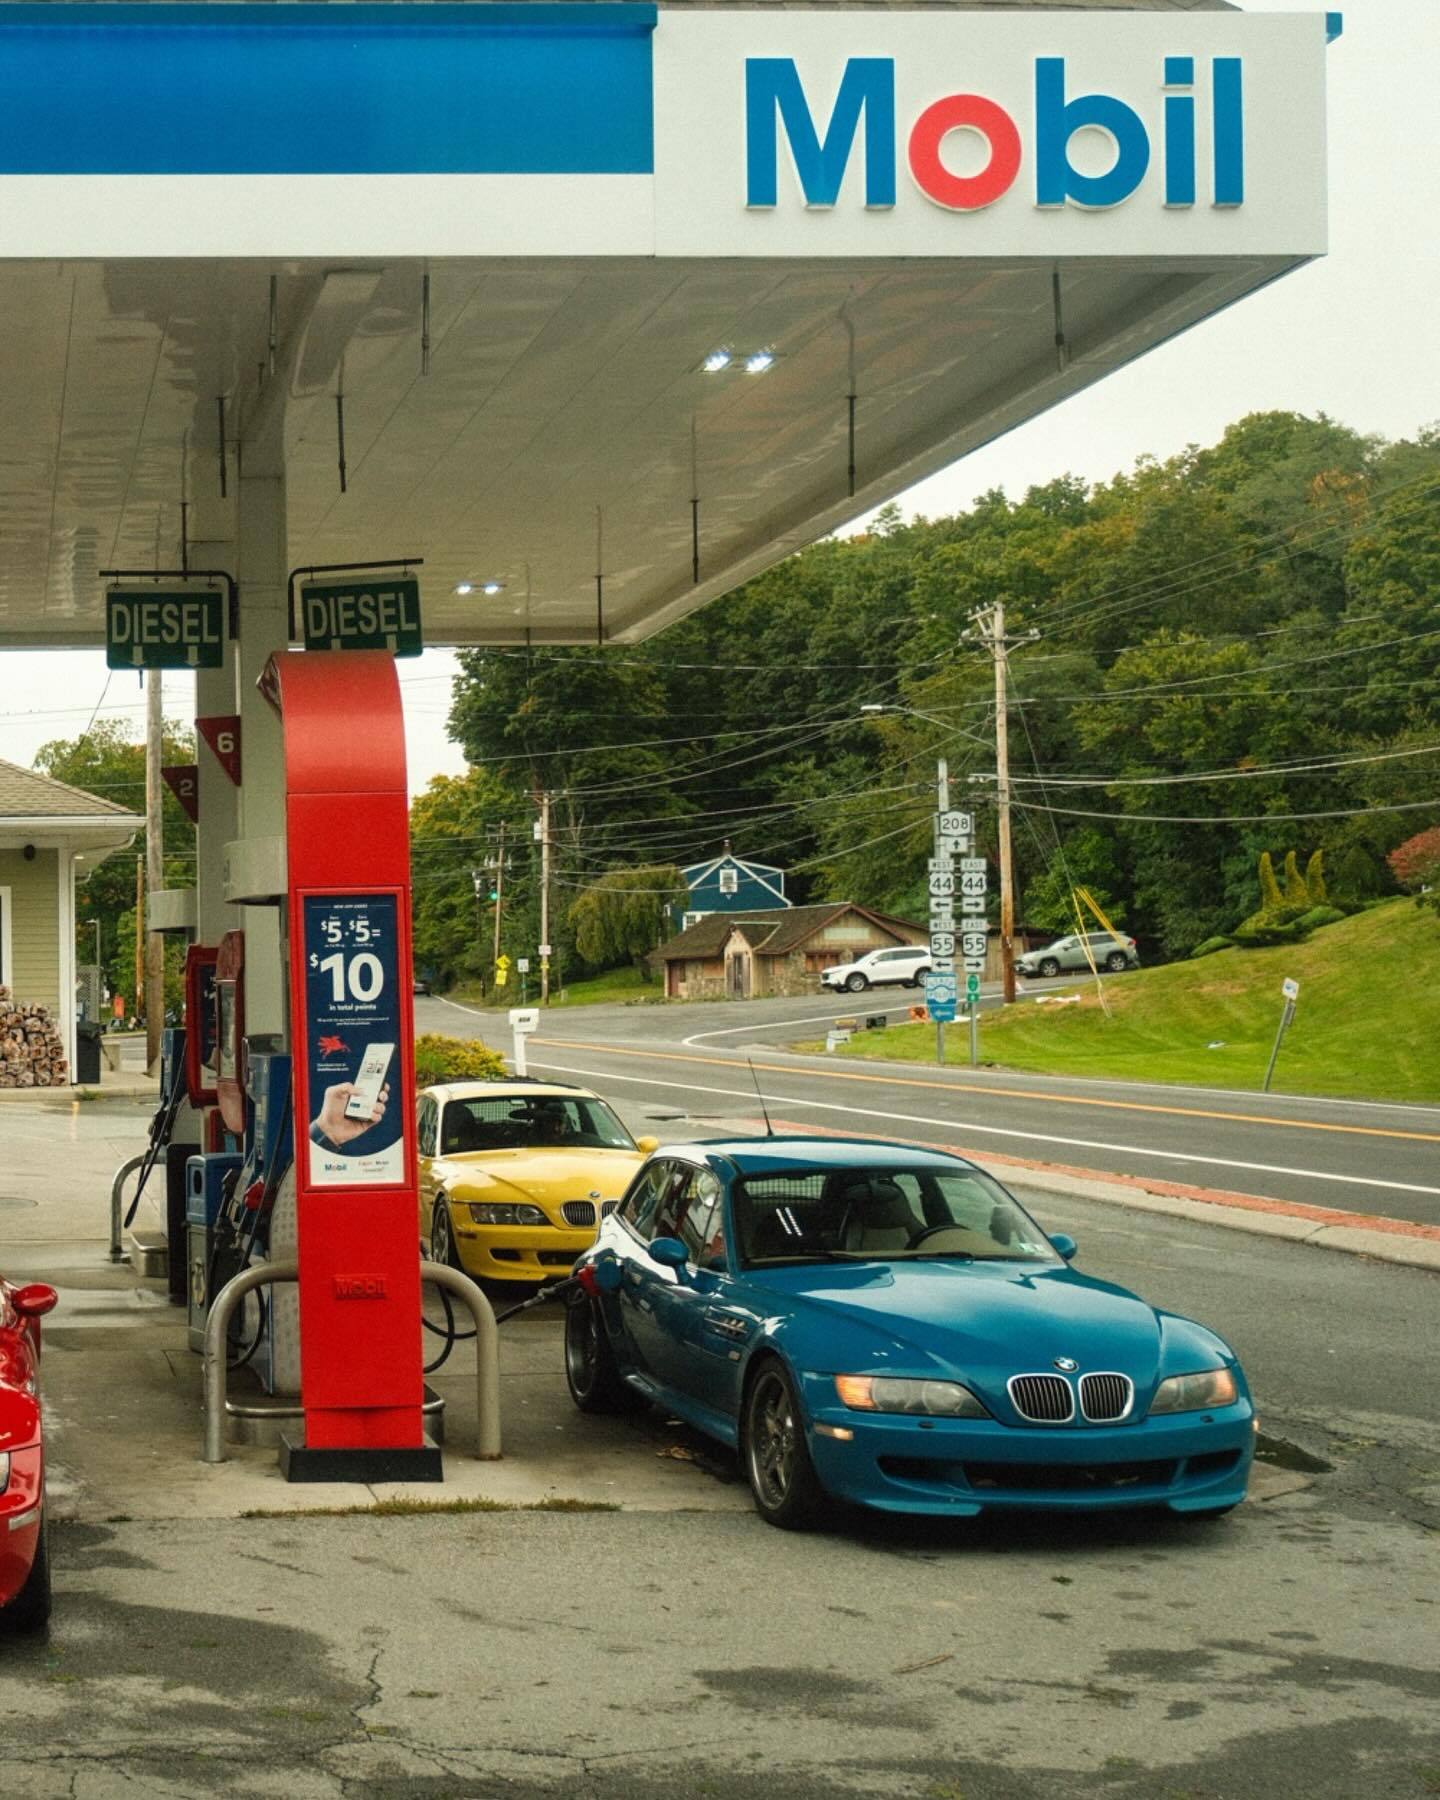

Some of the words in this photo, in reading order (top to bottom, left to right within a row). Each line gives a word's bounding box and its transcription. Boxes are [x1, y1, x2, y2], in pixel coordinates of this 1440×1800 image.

[745, 56, 1244, 210] Mobil
[307, 591, 417, 639] DIESEL
[111, 603, 219, 644] DIESEL
[216, 731, 235, 753] 6
[179, 779, 194, 796] 2
[942, 817, 969, 830] 208
[931, 877, 952, 891] 44
[964, 877, 984, 891] 44
[933, 937, 953, 951] 55
[965, 937, 985, 951] 55
[309, 952, 384, 1002] $10
[324, 1163, 348, 1172] Mobil
